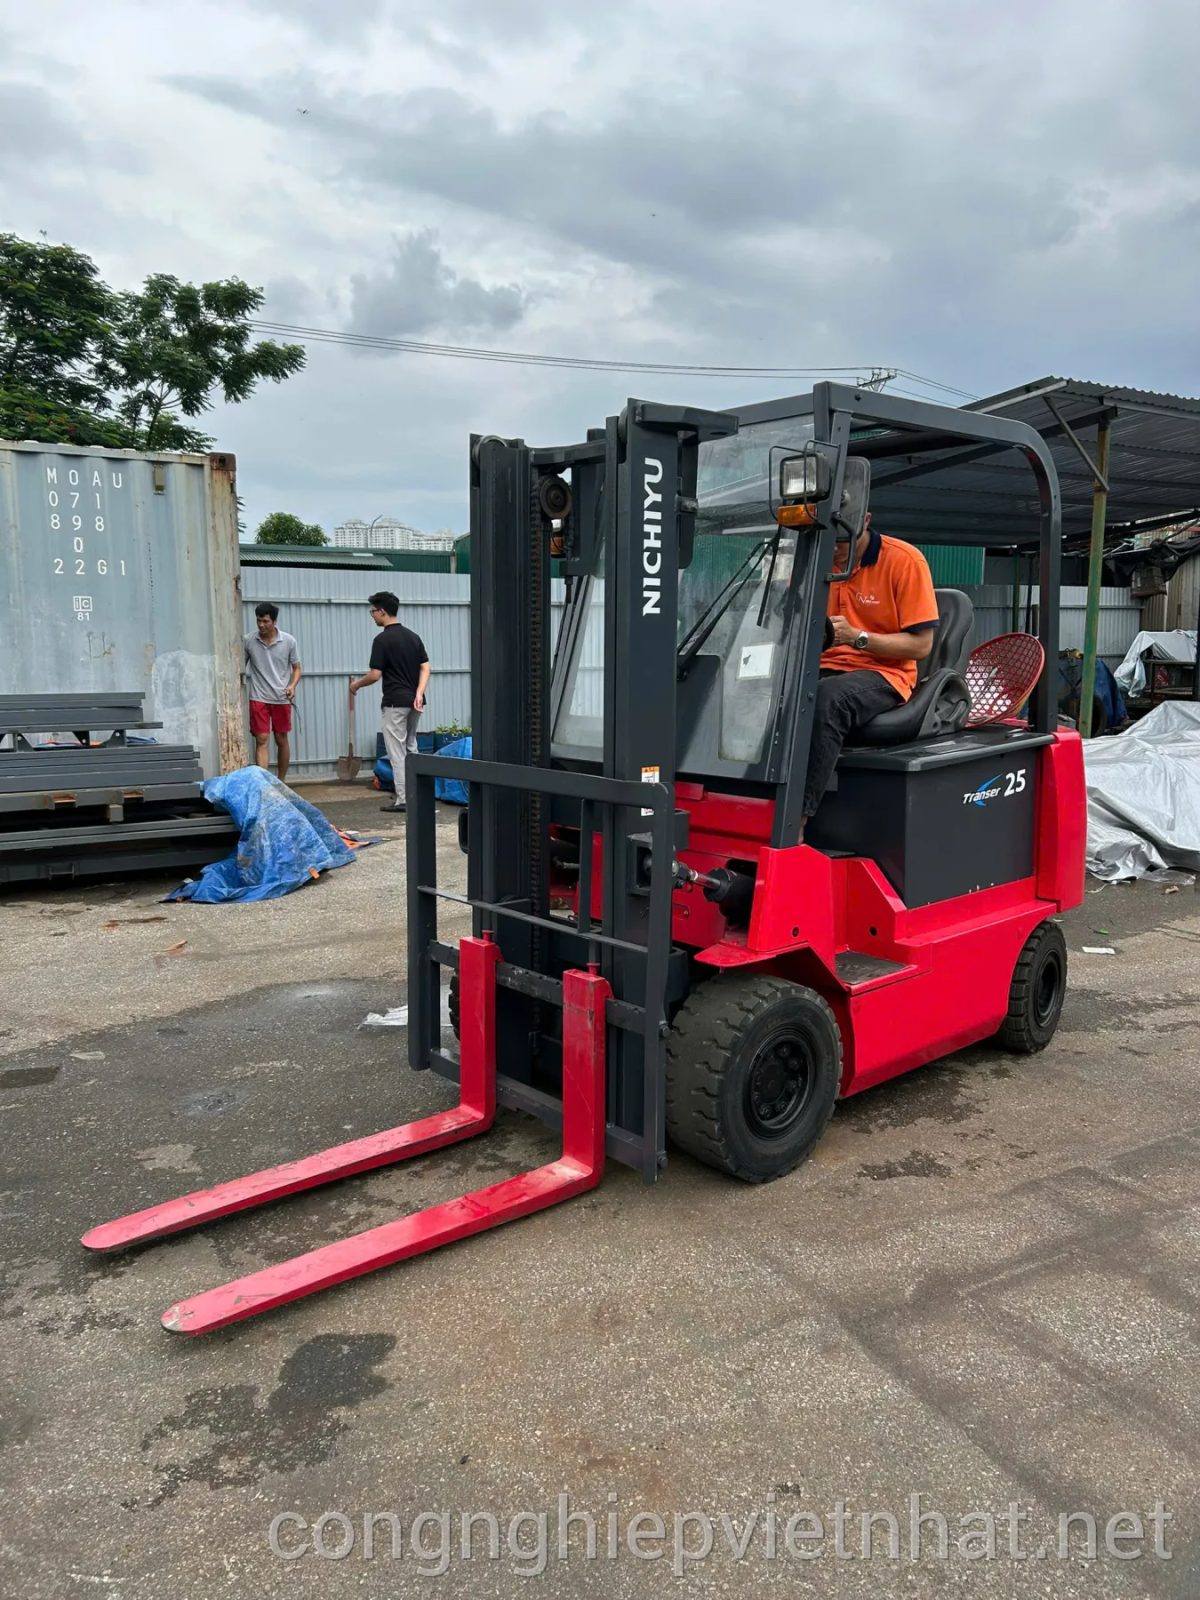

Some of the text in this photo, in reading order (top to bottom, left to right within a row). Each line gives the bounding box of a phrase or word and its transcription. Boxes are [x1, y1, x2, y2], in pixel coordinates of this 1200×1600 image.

[643, 457, 663, 616] NICHIYU
[963, 769, 1026, 805] Transer 25
